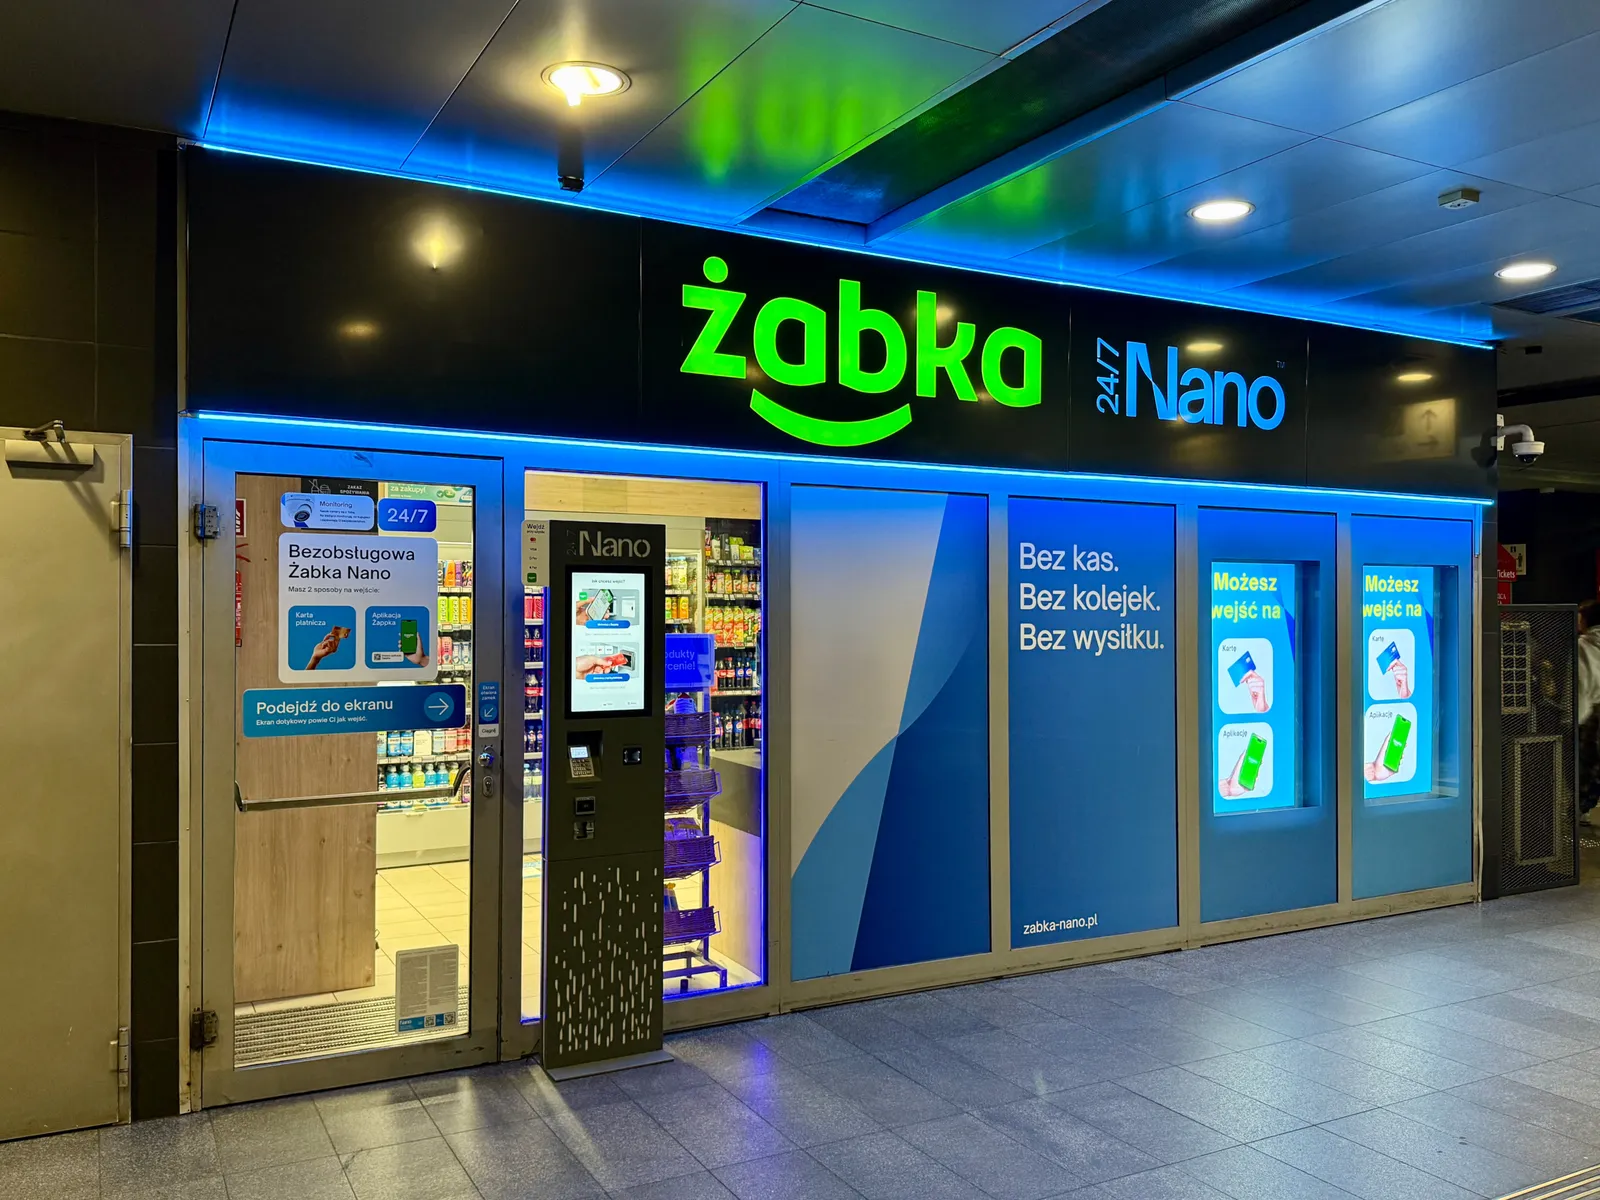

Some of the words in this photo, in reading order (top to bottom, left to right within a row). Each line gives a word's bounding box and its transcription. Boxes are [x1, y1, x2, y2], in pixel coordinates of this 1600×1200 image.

[680, 256, 1041, 407] żabka
[1096, 337, 1119, 414] 24/7
[1126, 341, 1286, 430] Nano
[319, 501, 353, 509] Monitoring
[387, 508, 429, 523] 24/7
[289, 544, 415, 563] Bezobsługowa
[579, 530, 651, 558] Nano
[1020, 542, 1066, 571] Bez
[1073, 544, 1119, 572] kas.
[288, 561, 341, 579] Żabka
[347, 566, 391, 580] Nano
[1213, 572, 1278, 591] Możesz
[1365, 575, 1419, 593] Możesz
[1020, 583, 1066, 610] Bez
[1073, 583, 1161, 617] kolejek.
[1363, 600, 1402, 621] wejść
[1406, 604, 1422, 617] na
[372, 612, 401, 620] Aplikacja
[1212, 600, 1258, 623] wejść
[1262, 605, 1281, 619] na
[1020, 623, 1066, 651] Bez
[1072, 623, 1165, 656] wysiłku.
[256, 700, 317, 716] Podejdź
[321, 700, 340, 712] do
[344, 699, 393, 711] ekranu
[276, 718, 307, 726] dotykowy
[336, 715, 346, 723] jak
[347, 715, 368, 723] wejść.
[1023, 913, 1098, 935] zabka-nano.pl
